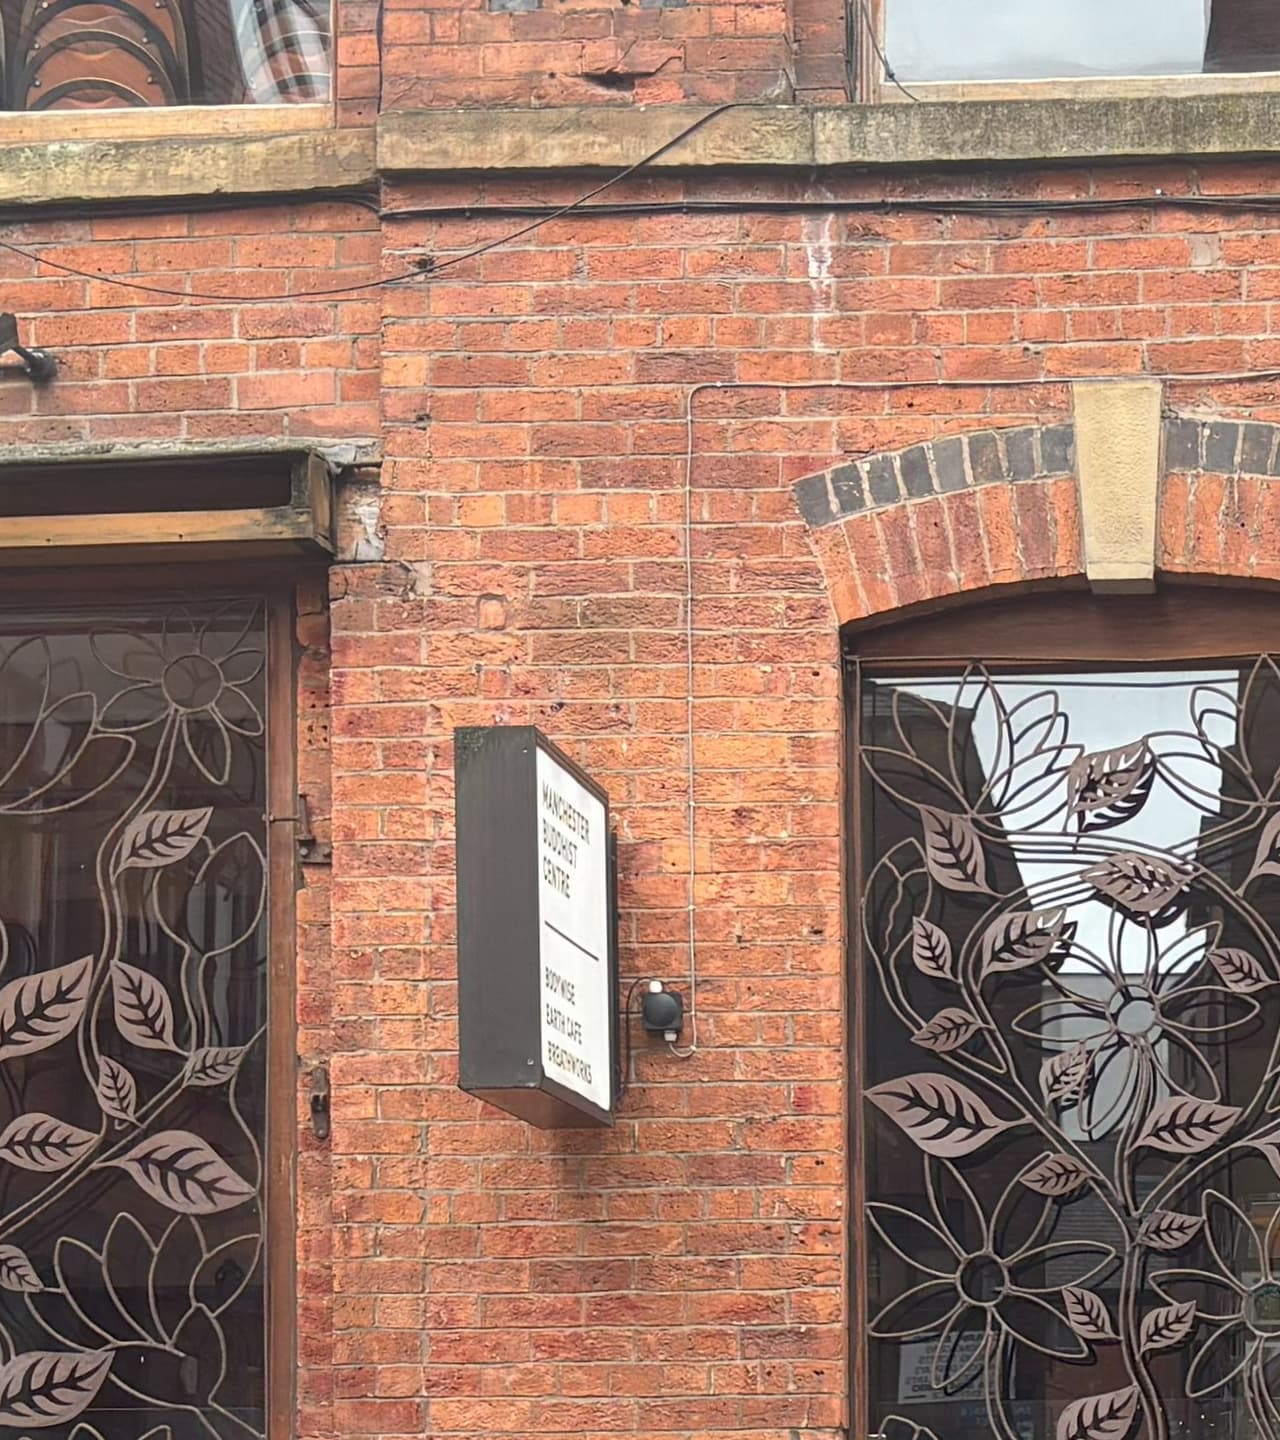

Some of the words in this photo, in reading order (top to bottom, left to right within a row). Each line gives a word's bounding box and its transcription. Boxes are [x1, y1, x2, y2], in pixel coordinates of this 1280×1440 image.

[542, 780, 590, 845] MANCHESTER
[543, 818, 578, 869] BUDDHIST
[543, 856, 570, 899] CENTRE
